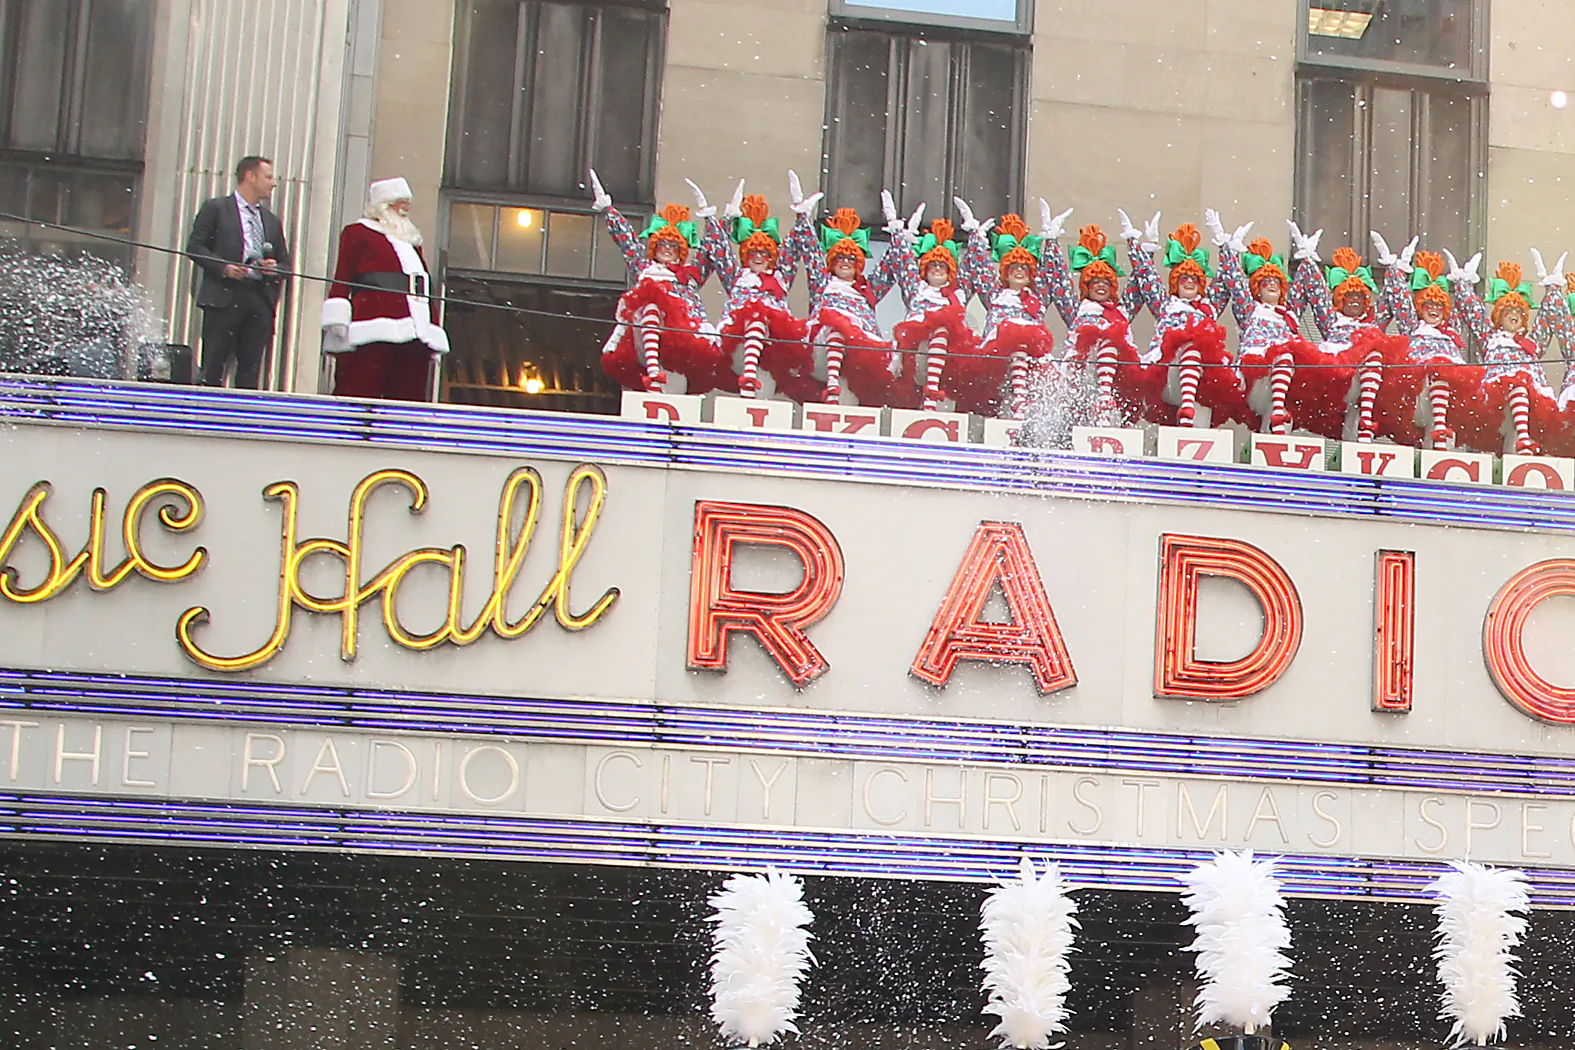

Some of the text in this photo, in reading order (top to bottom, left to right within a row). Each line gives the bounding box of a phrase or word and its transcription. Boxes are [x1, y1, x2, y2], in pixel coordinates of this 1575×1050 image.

[176, 461, 621, 673] Hall
[1, 719, 157, 789] THE
[240, 732, 520, 806] RADIO
[595, 750, 789, 820] CITY
[862, 767, 1342, 849] CHRISTMAS
